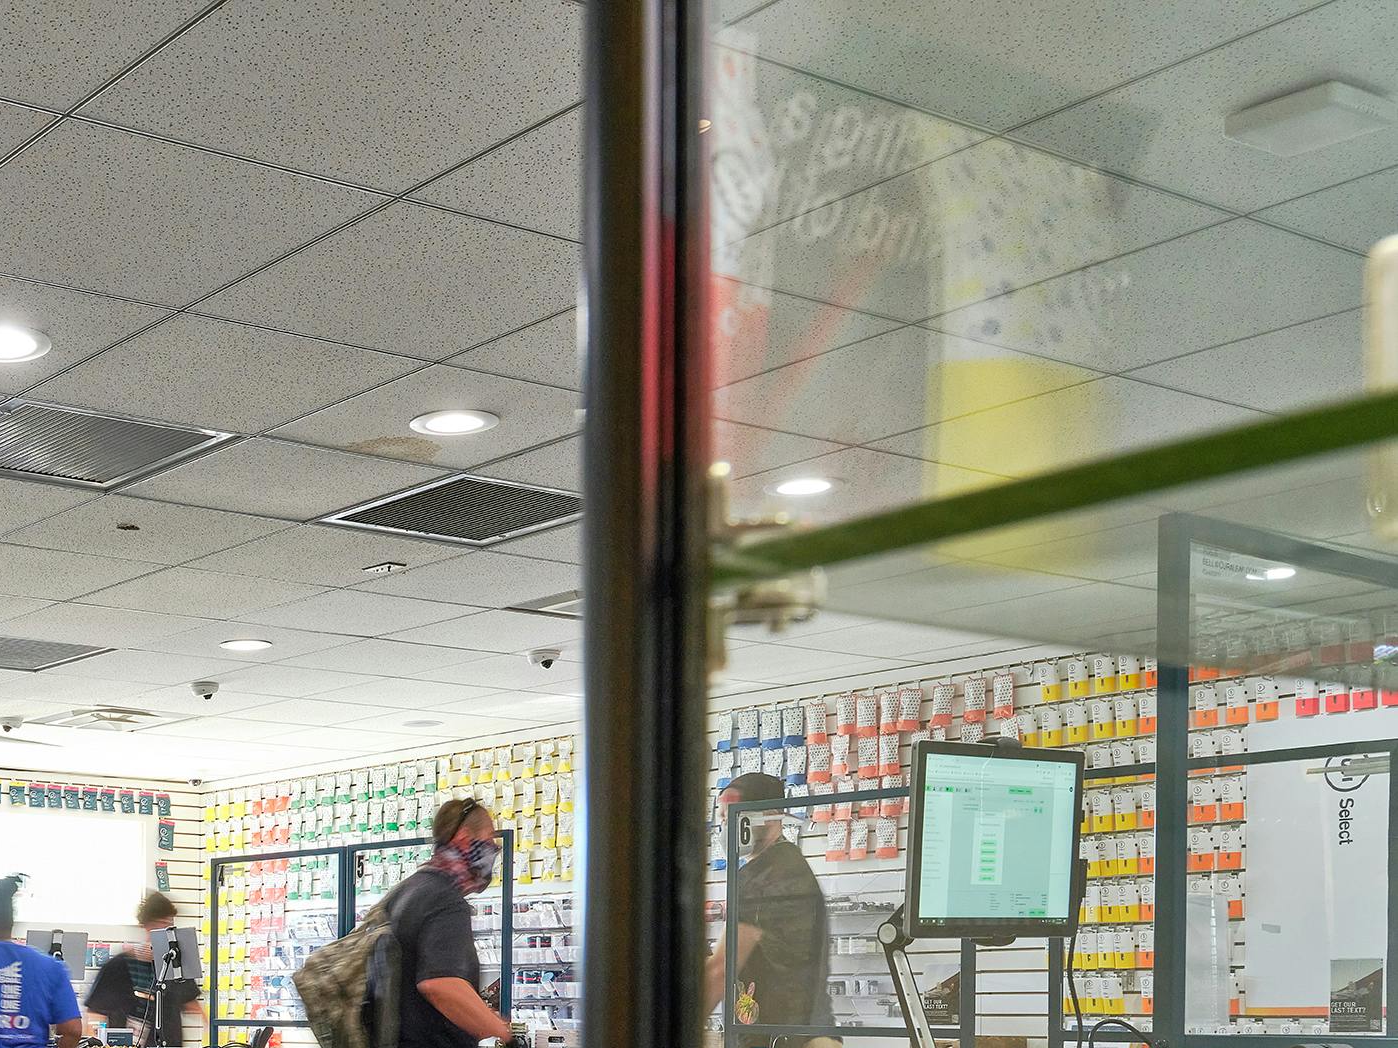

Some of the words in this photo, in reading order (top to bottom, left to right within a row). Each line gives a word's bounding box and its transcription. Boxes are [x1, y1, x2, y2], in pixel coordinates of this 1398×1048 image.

[740, 816, 751, 845] 6
[1338, 798, 1354, 845] Select
[219, 865, 225, 886] 4
[357, 855, 365, 878] 5
